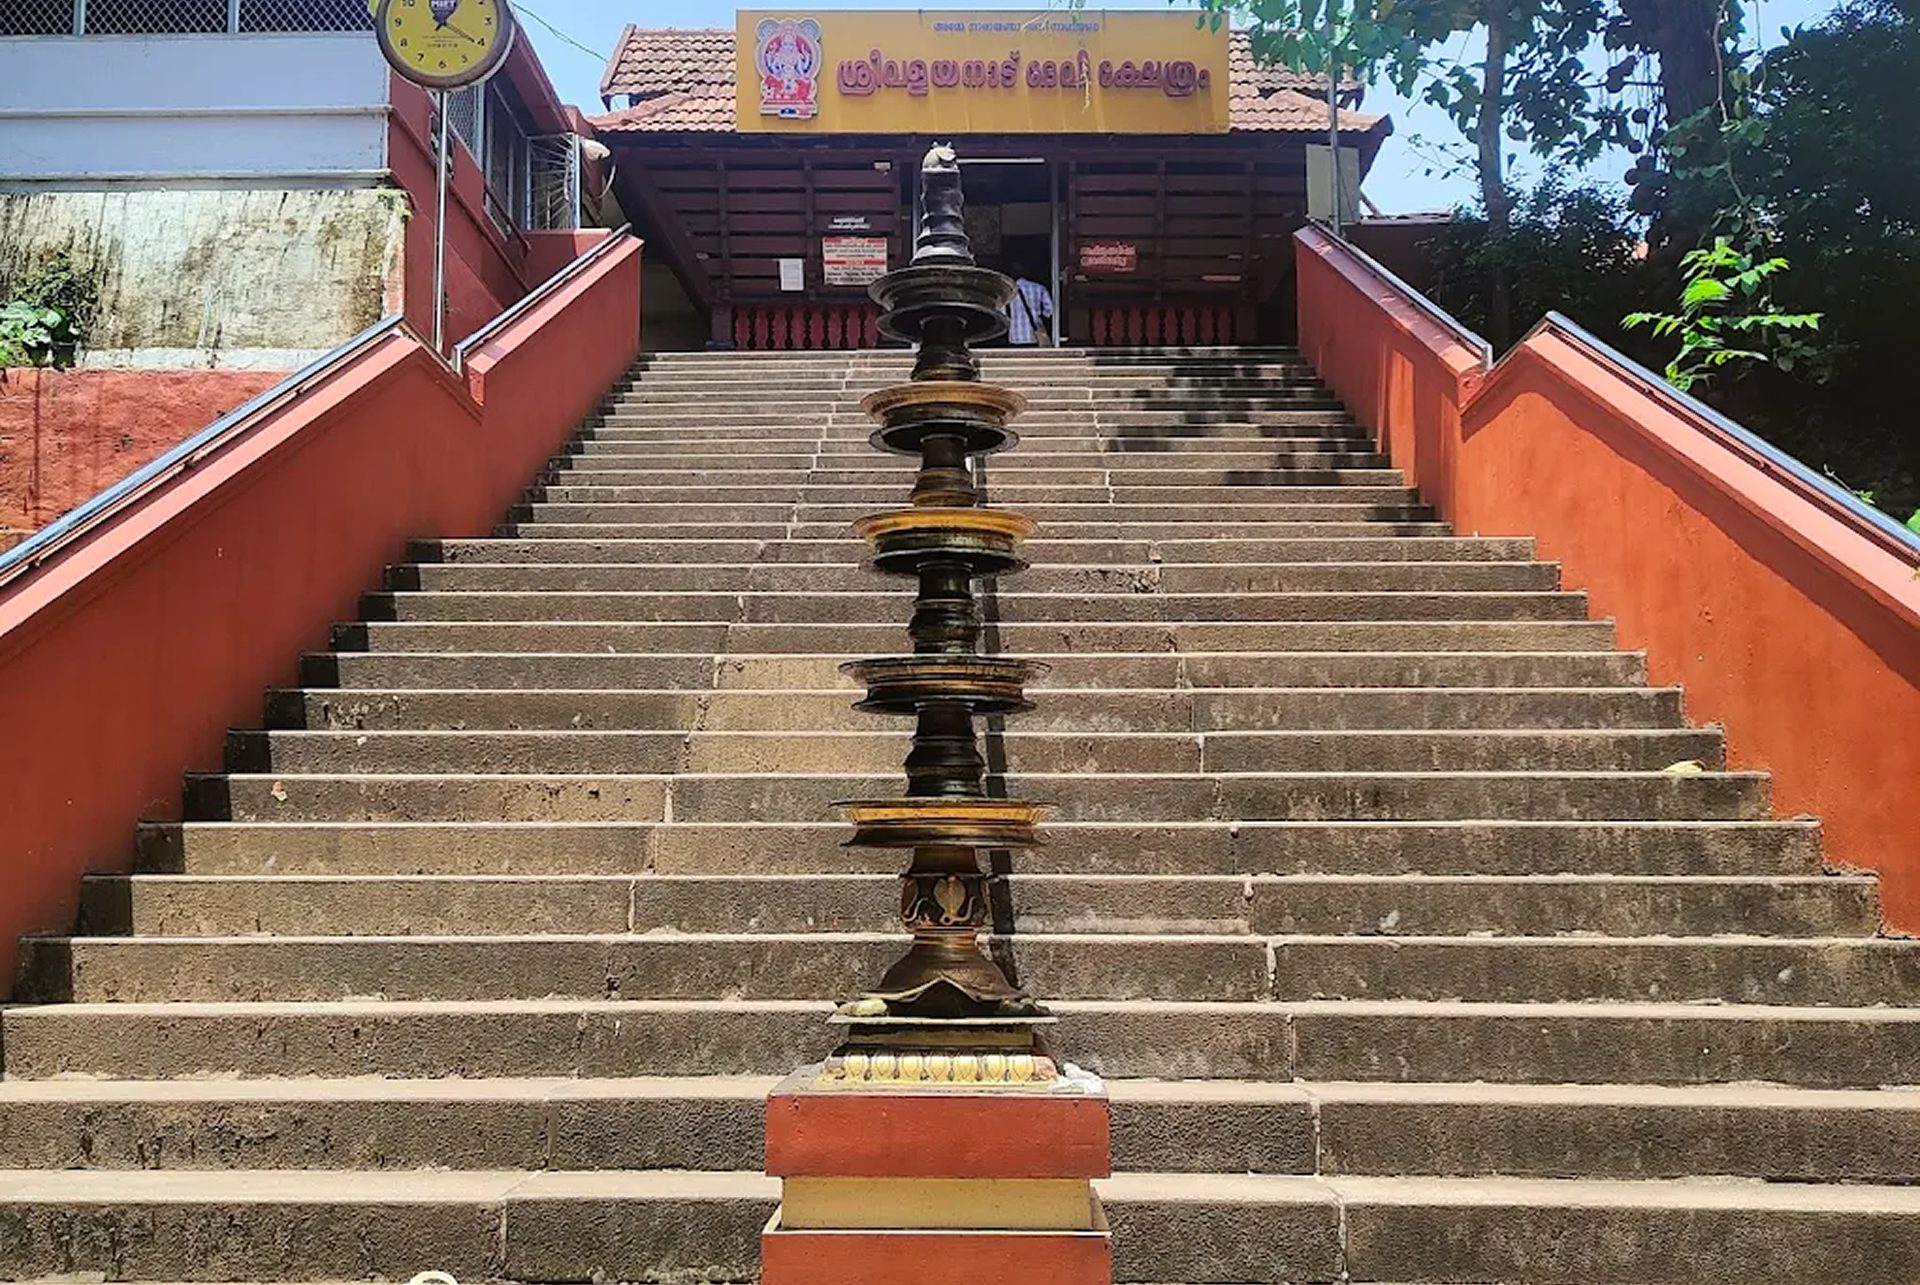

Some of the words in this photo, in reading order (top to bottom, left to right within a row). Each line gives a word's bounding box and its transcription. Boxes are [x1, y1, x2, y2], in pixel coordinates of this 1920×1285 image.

[394, 17, 402, 27] 9
[484, 17, 492, 26] 3
[400, 38, 408, 47] 8
[477, 38, 485, 47] 4
[416, 53, 425, 62] 7
[461, 55, 468, 64] 5
[438, 60, 447, 69] 6
